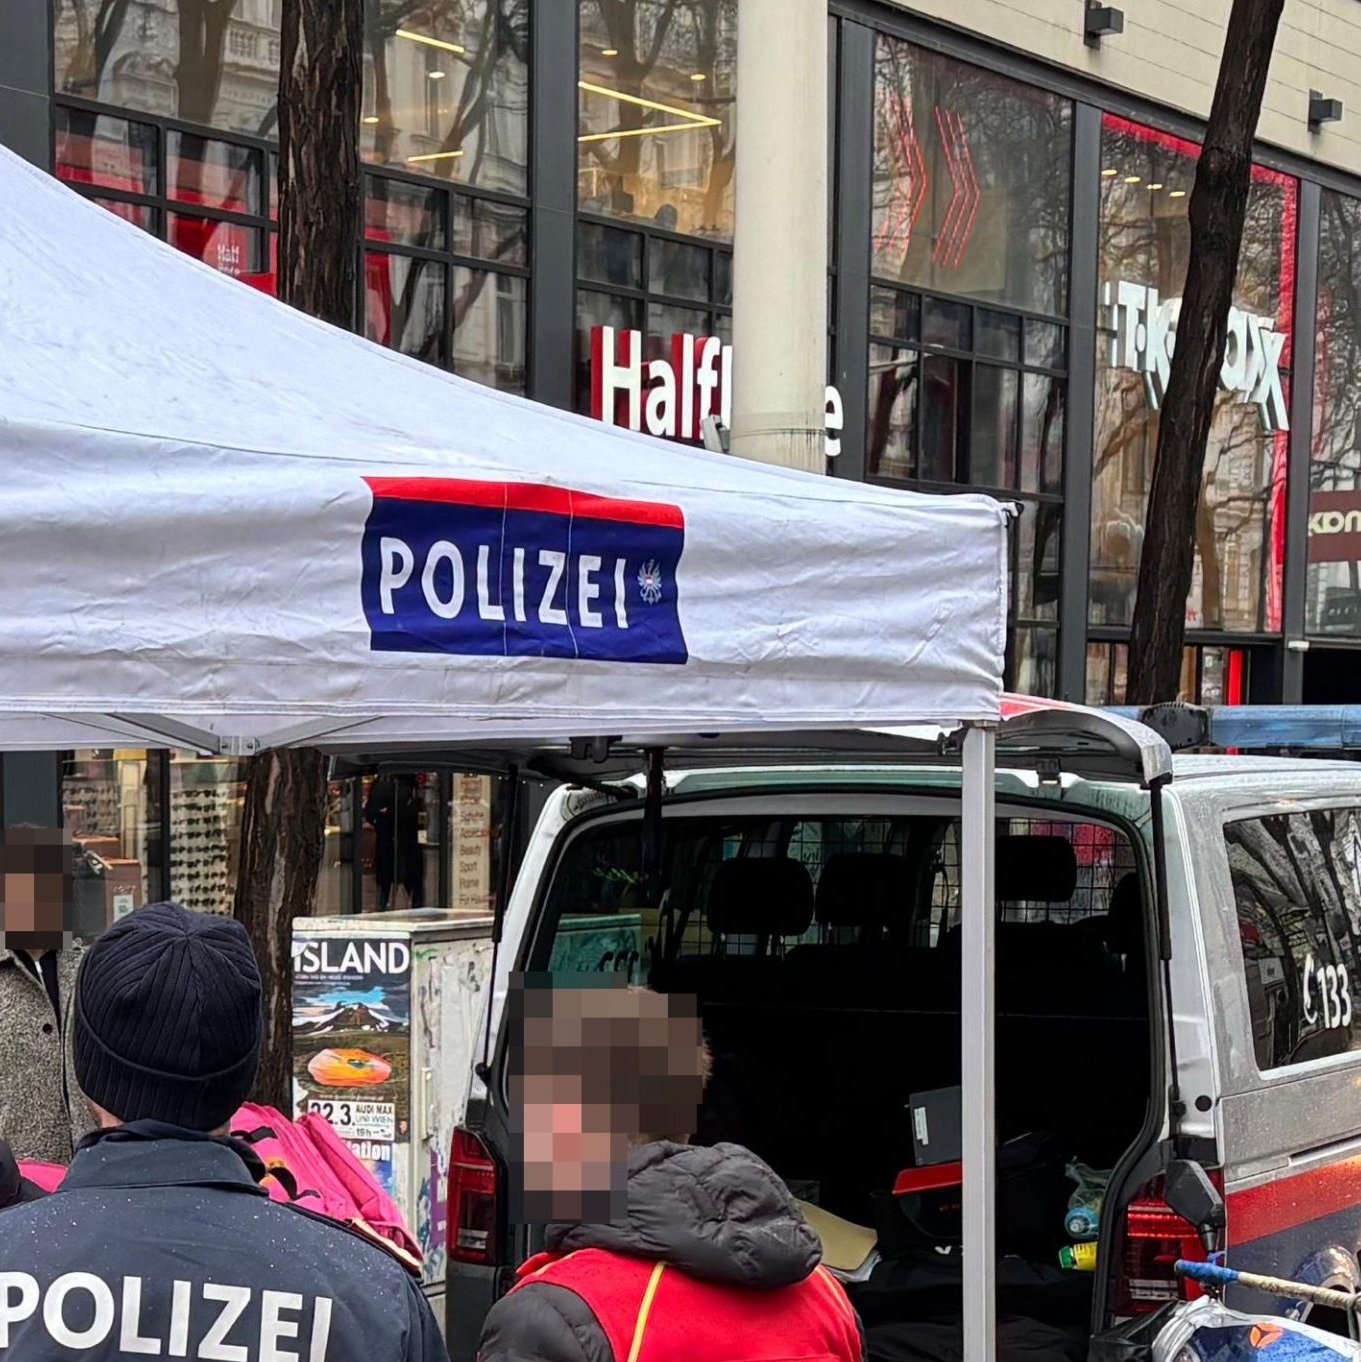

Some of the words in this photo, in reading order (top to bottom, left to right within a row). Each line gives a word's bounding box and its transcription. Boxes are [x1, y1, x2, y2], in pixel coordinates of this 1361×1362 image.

[380, 537, 629, 630] POLIZEI
[1317, 963, 1352, 1029] 133
[356, 1104, 374, 1114] AUDI
[376, 1104, 393, 1114] MAX
